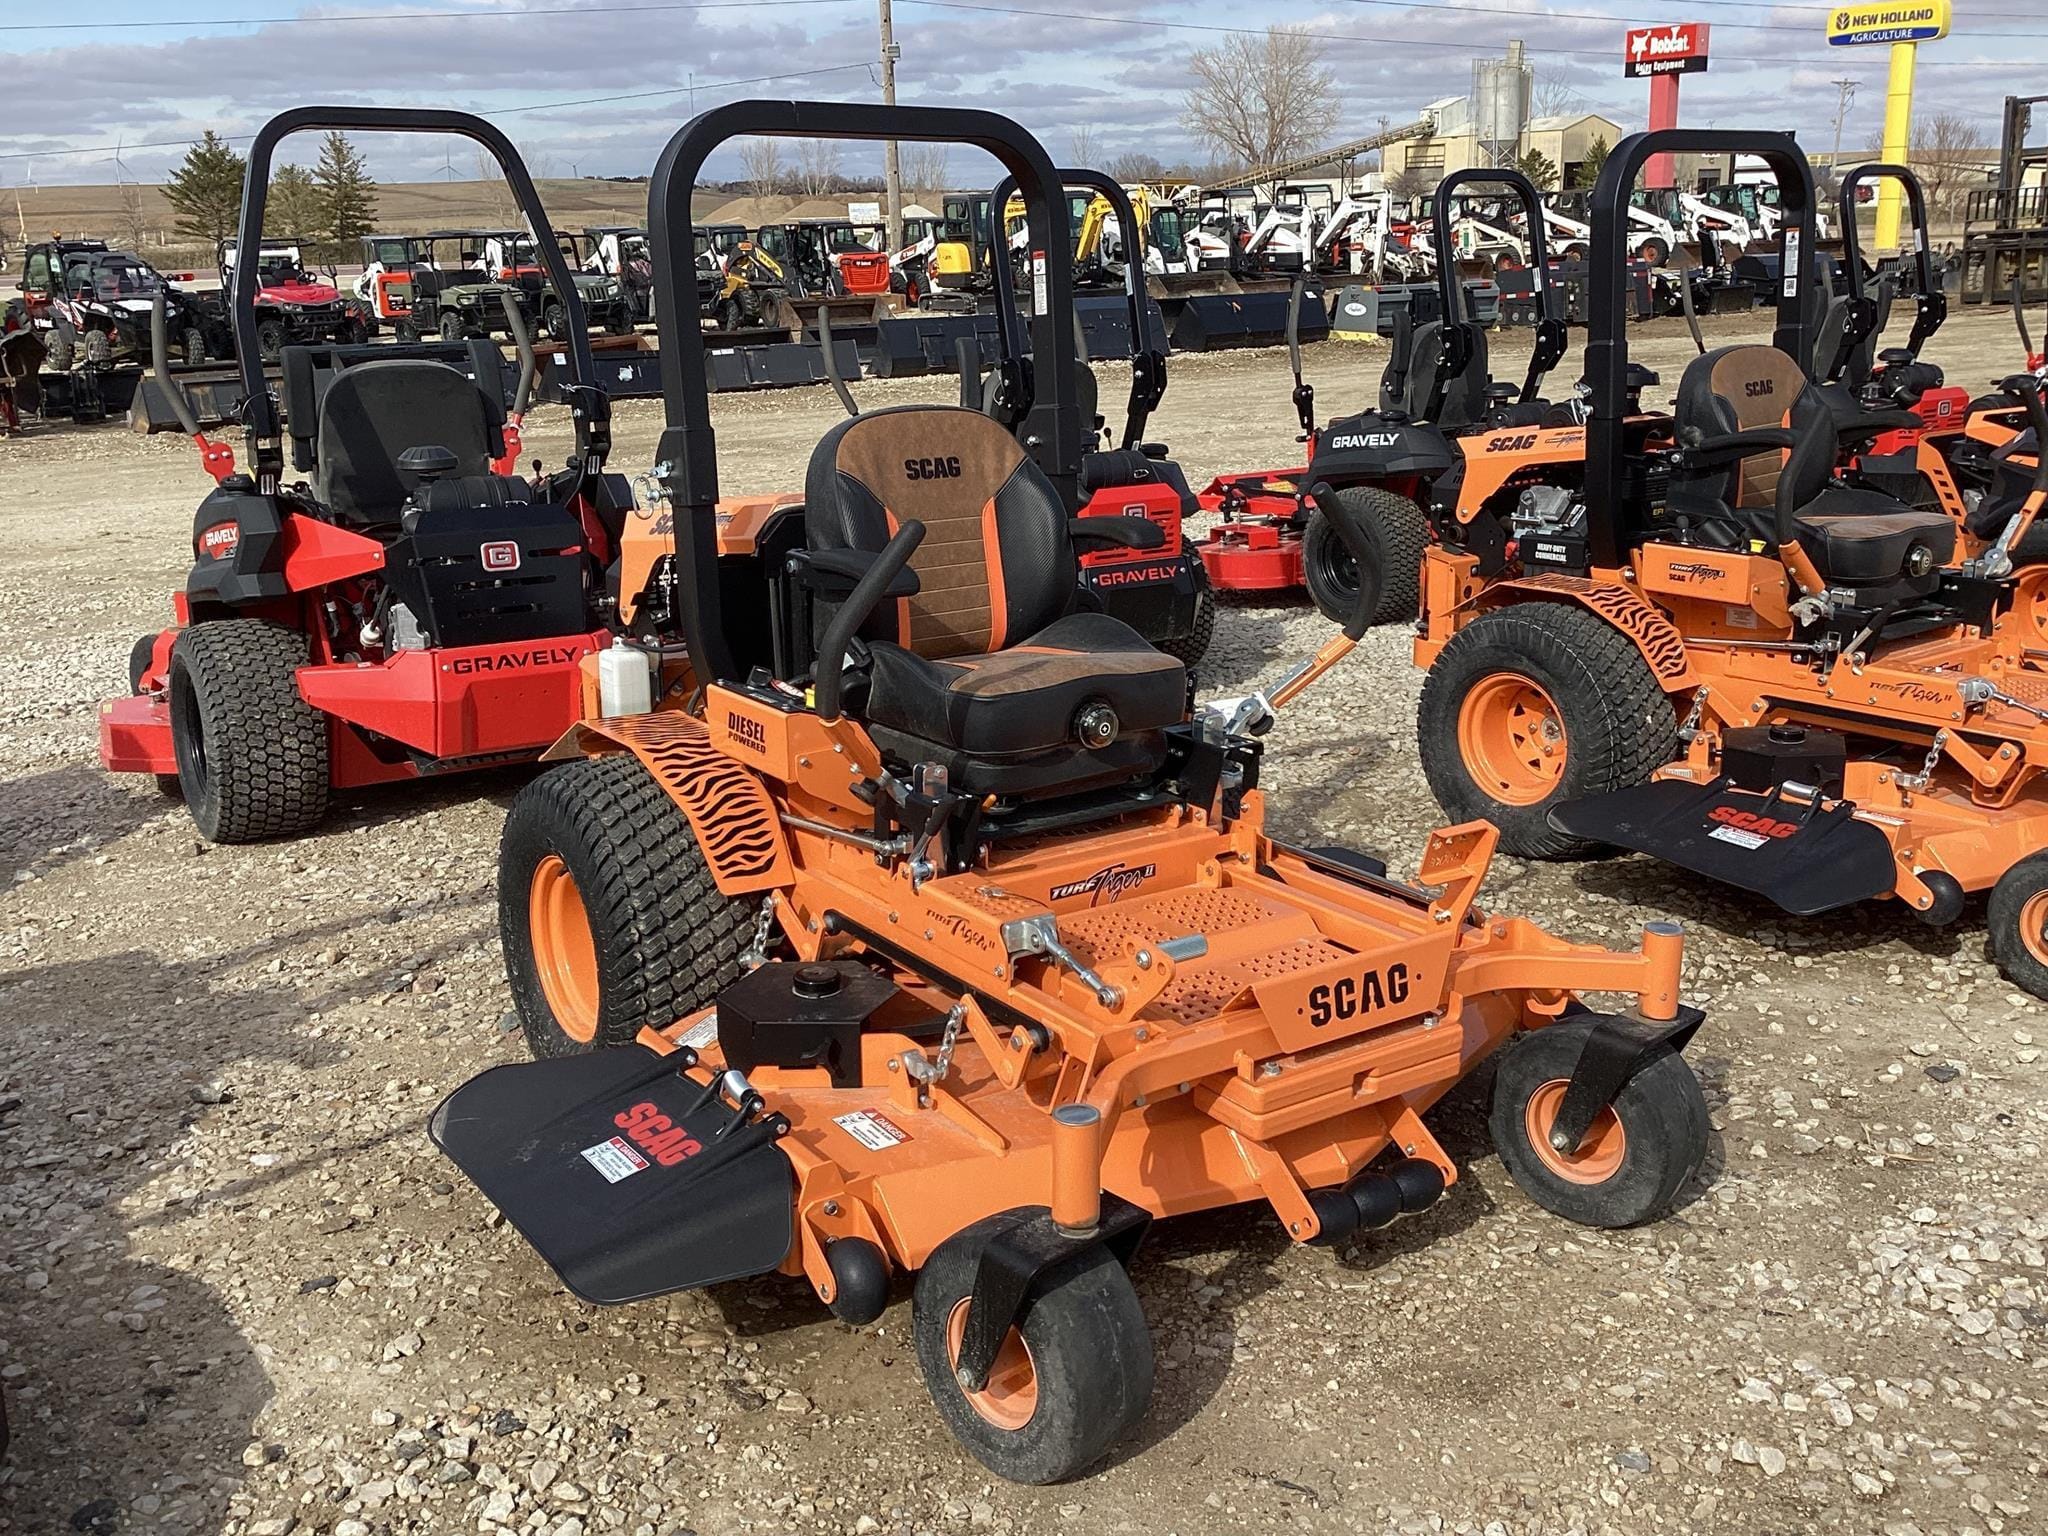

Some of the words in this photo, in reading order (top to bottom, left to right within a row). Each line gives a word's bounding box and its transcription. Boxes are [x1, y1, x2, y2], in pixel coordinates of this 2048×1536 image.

[1852, 13, 1878, 27] NEW
[1880, 8, 1933, 24] HOLLAND
[1650, 34, 1690, 56] Bobcat
[1849, 28, 1913, 43] AGRICULTURE
[1745, 379, 1774, 397] SCAG
[1332, 433, 1400, 449] GRAVELY
[1486, 434, 1538, 453] SCAG
[904, 456, 961, 481] SCAG
[205, 527, 238, 547] GRAVELY
[1098, 565, 1177, 586] GRAVELY
[1668, 573, 1686, 582] SCAG
[453, 646, 578, 675] GRAVELY
[728, 711, 765, 743] DIESEL
[728, 730, 766, 755] POWERED
[1707, 806, 1798, 838] SCAG
[1051, 879, 1098, 900] TURF
[1087, 862, 1143, 908] Tiger
[1308, 962, 1410, 1028] SCAG
[613, 1102, 703, 1167] SCAG
[876, 1118, 907, 1140] DANGER
[620, 1146, 640, 1165] DANGER
